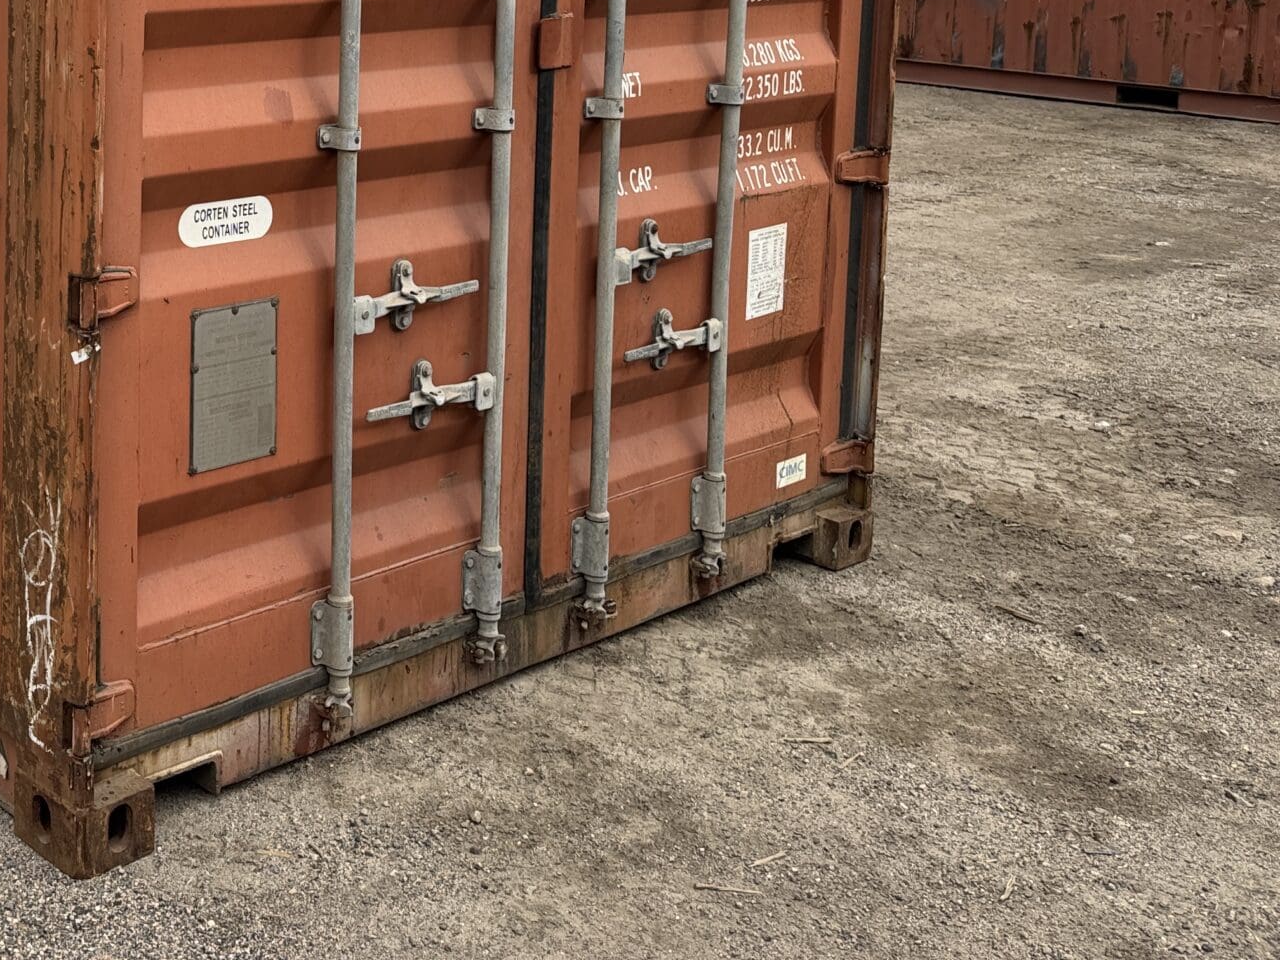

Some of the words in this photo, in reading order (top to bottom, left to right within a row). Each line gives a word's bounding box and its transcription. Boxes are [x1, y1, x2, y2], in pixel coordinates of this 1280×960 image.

[774, 38, 805, 63] KGS.
[783, 69, 806, 95] LBS.
[737, 132, 763, 159] 33.2
[630, 165, 658, 193] CAP.
[193, 206, 229, 224] CORTEN
[232, 202, 258, 218] STEEL
[202, 221, 251, 240] CONTAINER
[779, 460, 805, 479] CIMC
